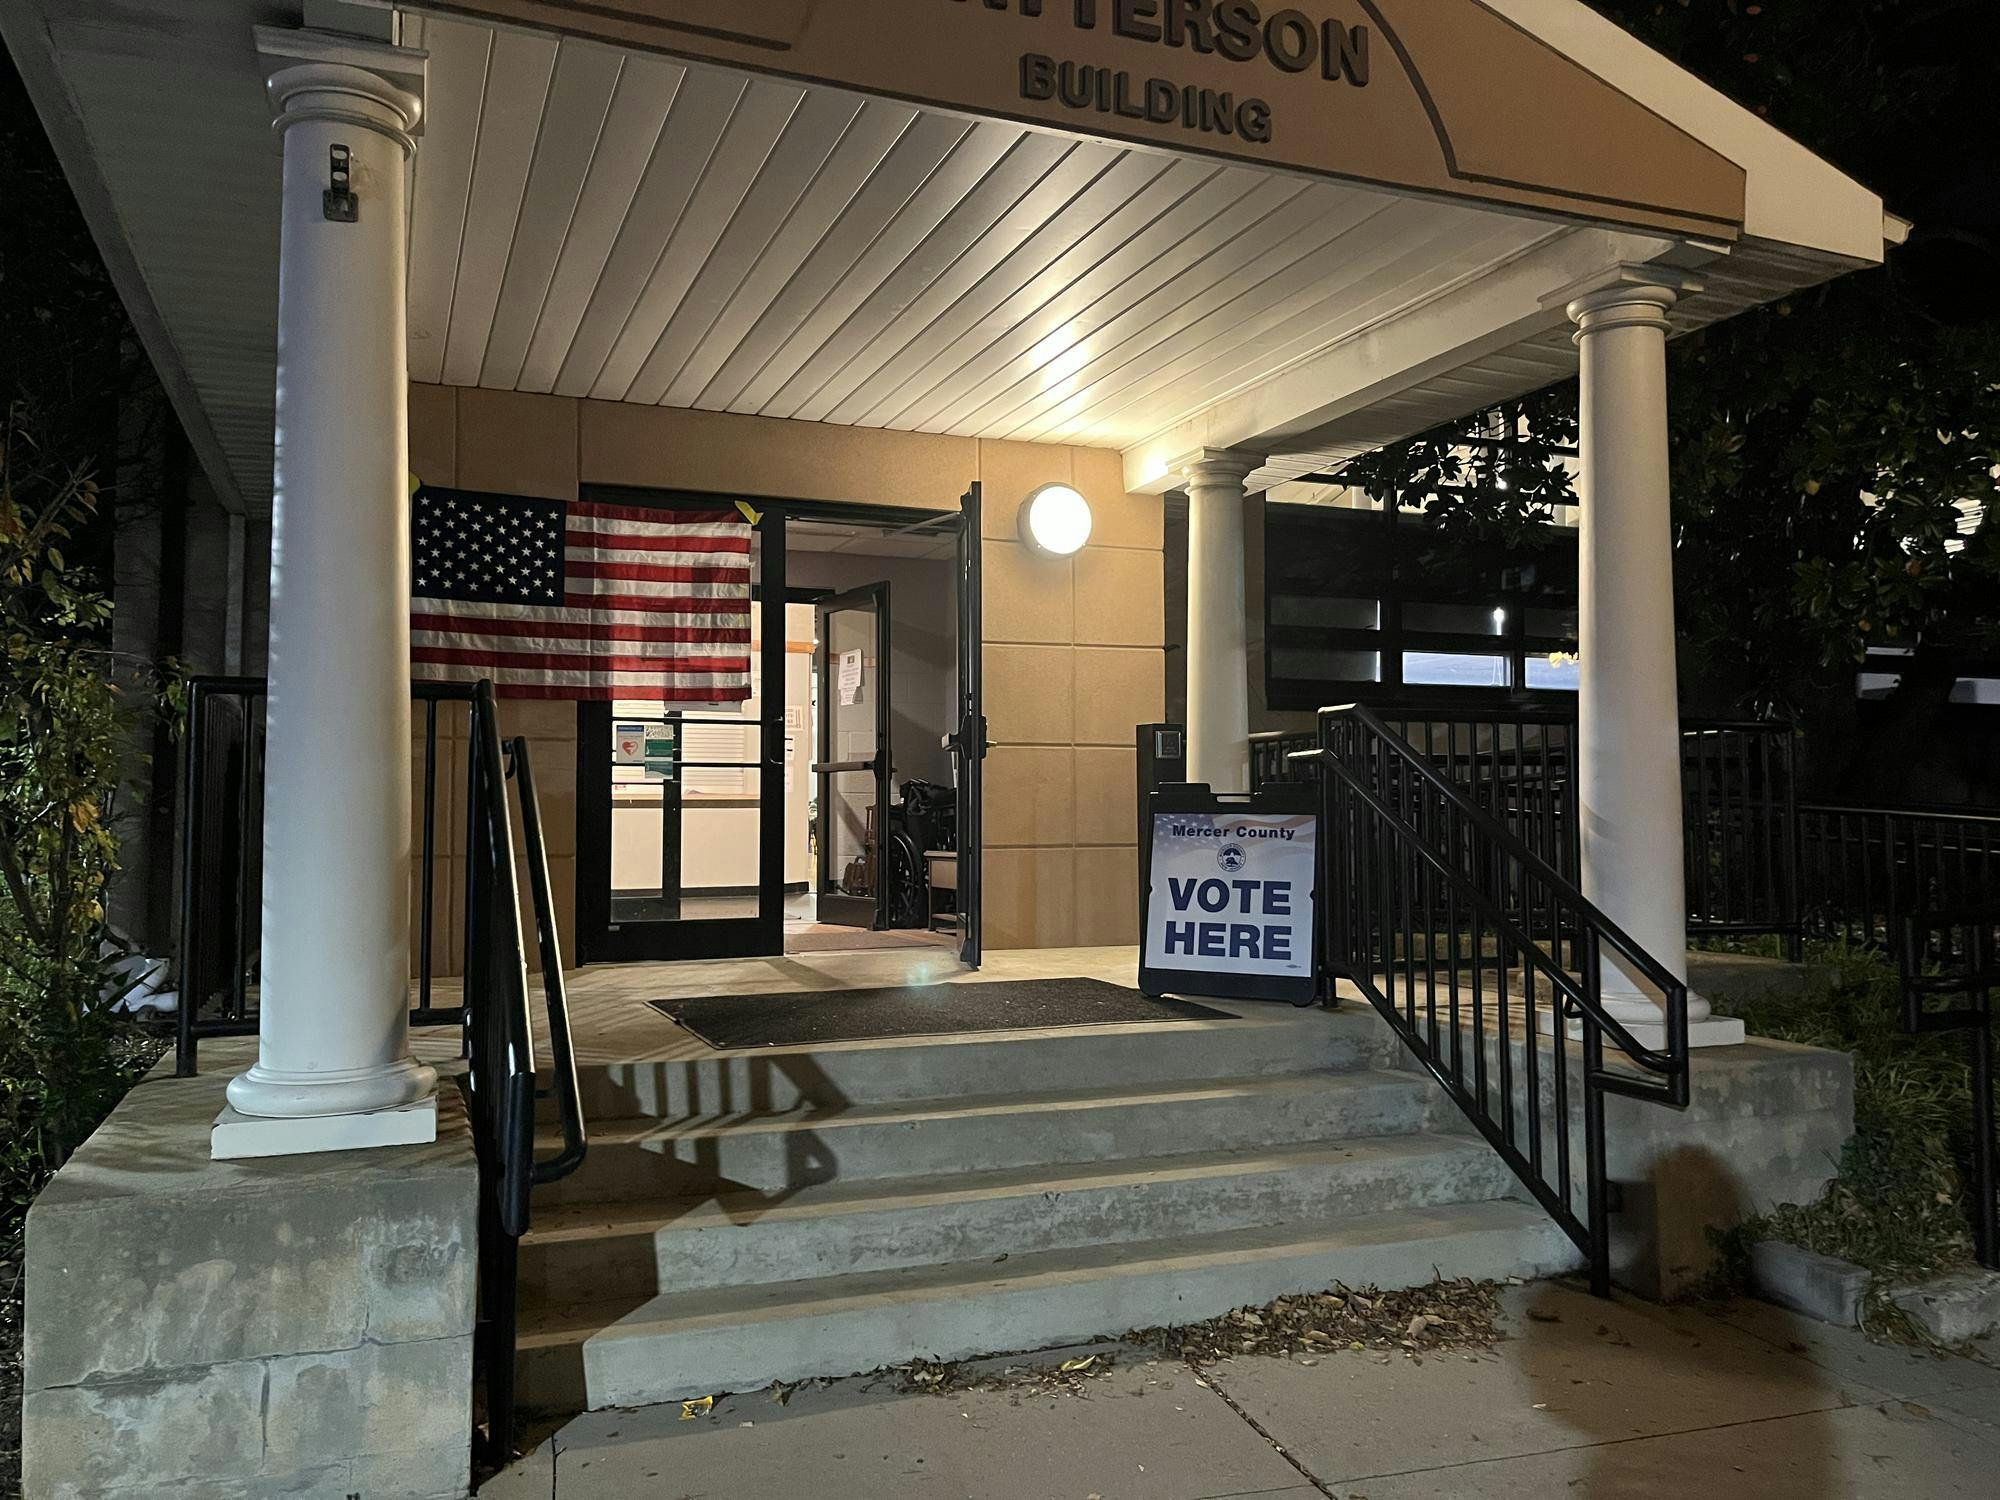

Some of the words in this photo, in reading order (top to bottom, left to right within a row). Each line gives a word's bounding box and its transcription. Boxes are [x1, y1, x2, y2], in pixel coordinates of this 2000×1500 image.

[1020, 53, 1271, 143] BUILDING
[1173, 825, 1230, 838] Mercer
[1236, 826, 1295, 840] County
[1168, 878, 1291, 915] VOTE
[1165, 921, 1291, 960] HERE
